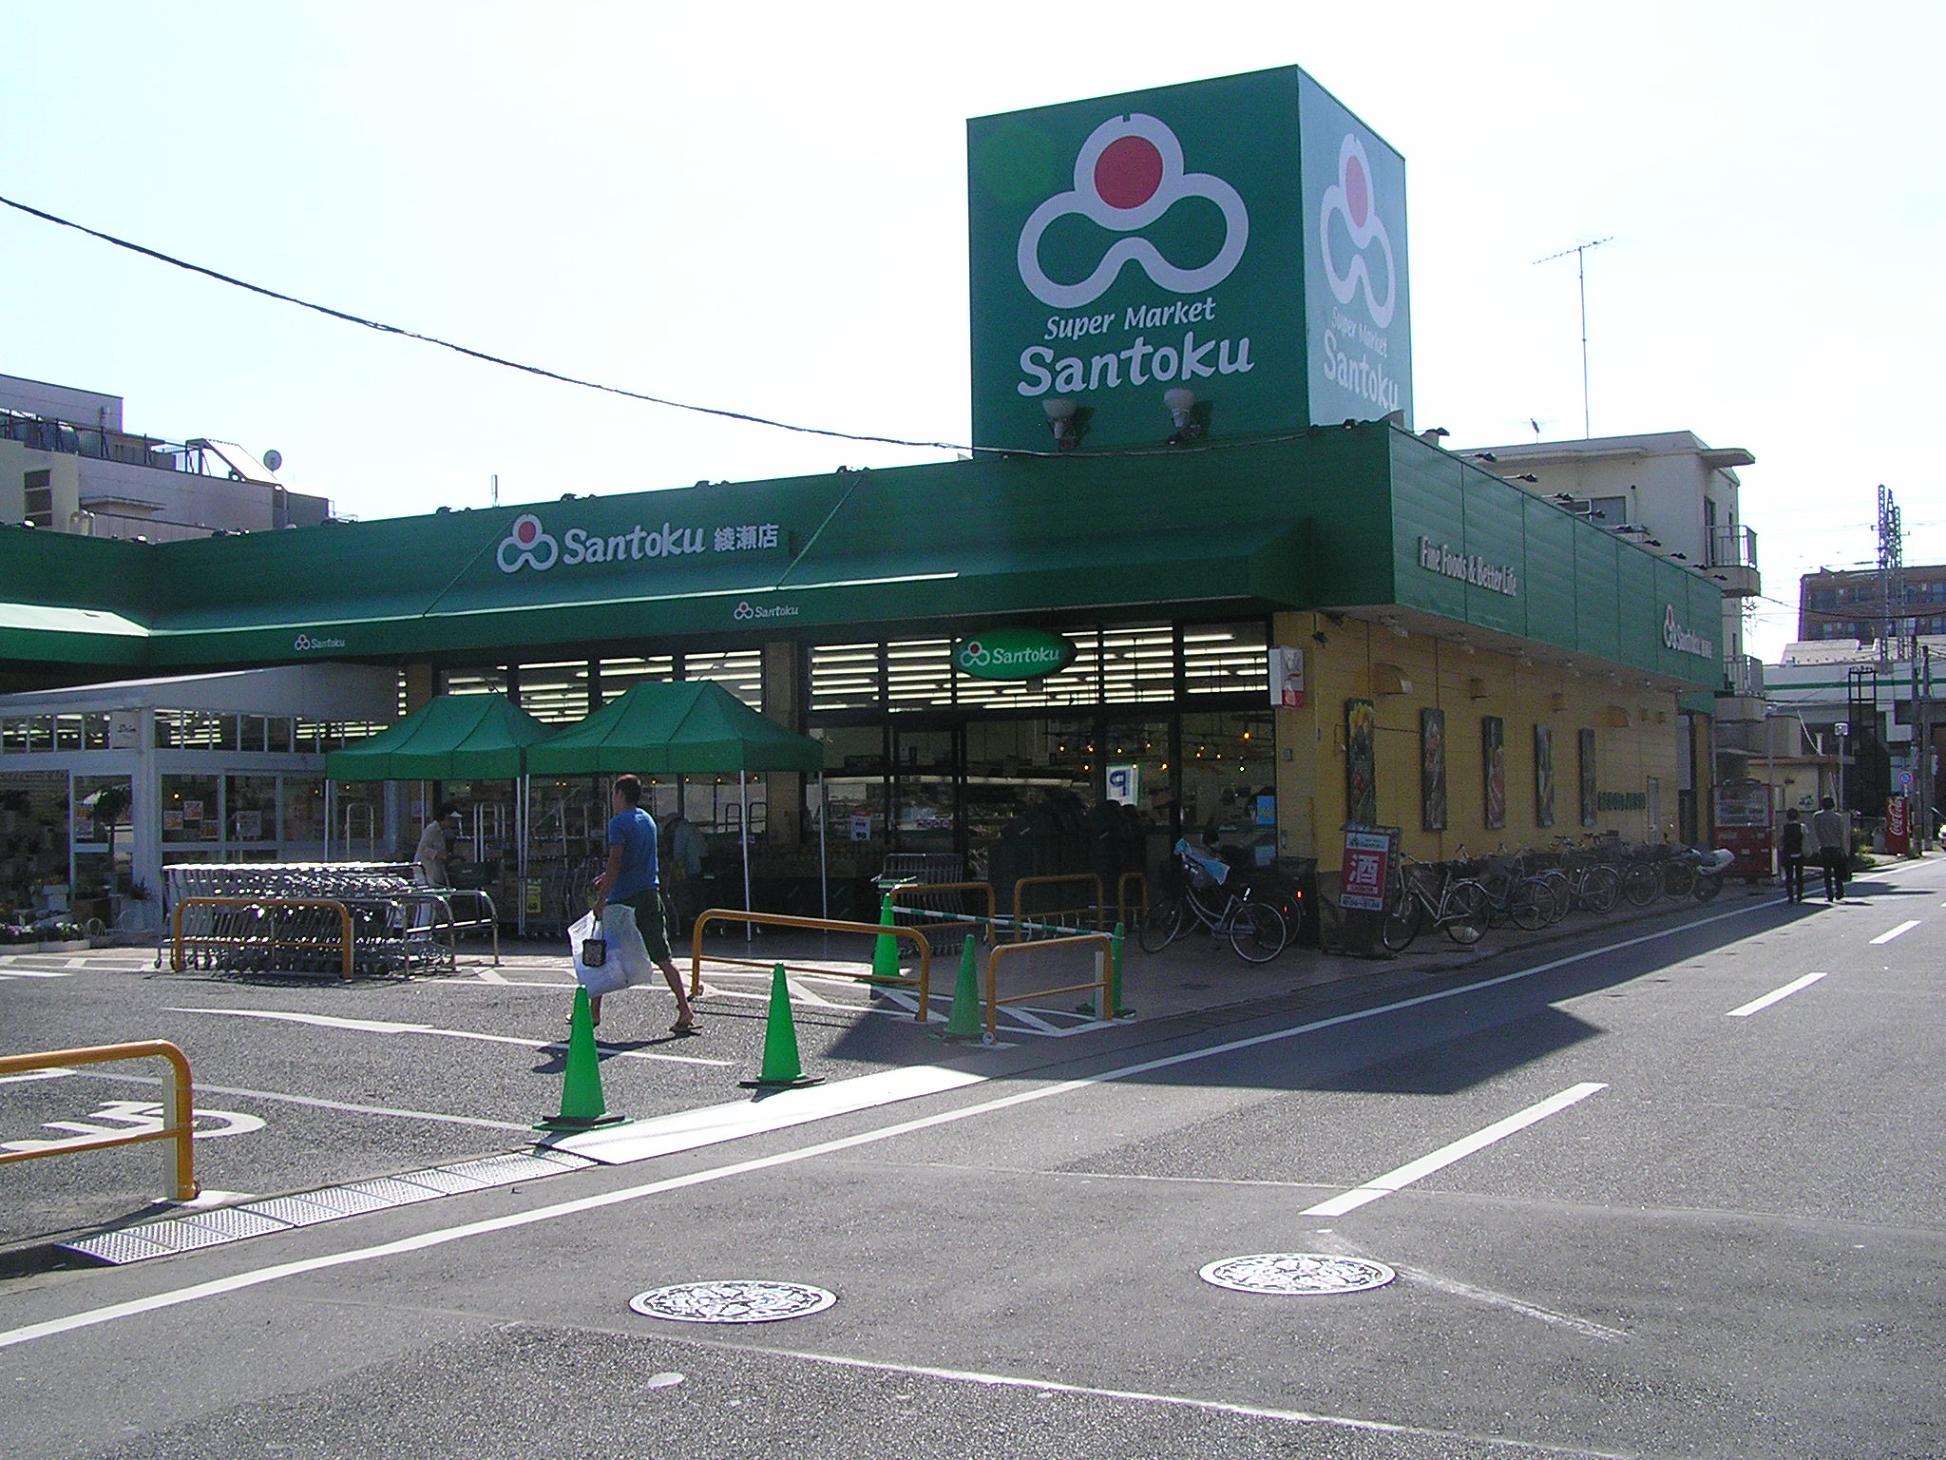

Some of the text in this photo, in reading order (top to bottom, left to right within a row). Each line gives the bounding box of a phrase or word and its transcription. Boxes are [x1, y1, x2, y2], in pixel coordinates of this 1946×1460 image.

[1044, 297, 1217, 341] Super Market
[1331, 306, 1357, 337] Super
[1017, 331, 1255, 397] Santoku
[1324, 329, 1399, 411] Santoku
[563, 522, 779, 565] Santoku 綾瀬店
[754, 604, 799, 618] Santoku
[992, 646, 1060, 664] Santoku
